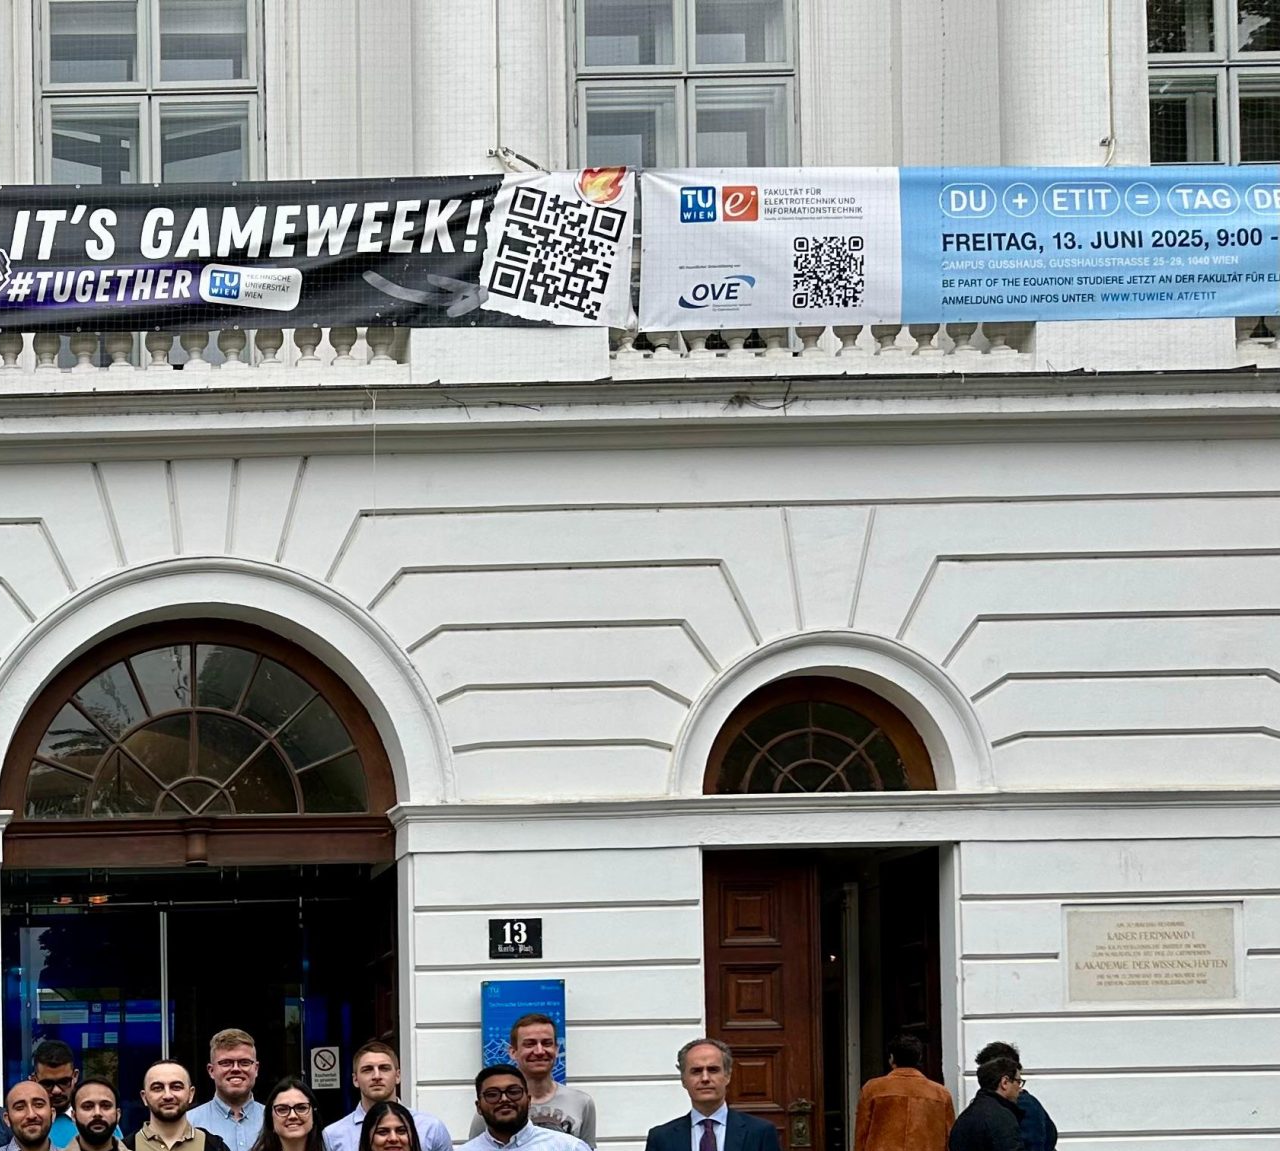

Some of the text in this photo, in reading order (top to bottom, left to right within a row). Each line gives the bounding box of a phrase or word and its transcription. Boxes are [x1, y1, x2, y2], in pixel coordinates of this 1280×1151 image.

[683, 189, 713, 208] TU
[764, 187, 821, 197] FAKULTÄT FÜR
[764, 197, 856, 206] ELEKTROTECHNIK UND
[950, 189, 987, 212] DU
[1053, 188, 1111, 211] ETIT
[1175, 189, 1231, 210] TAG
[683, 212, 714, 220] WIEN
[764, 206, 863, 215] INFORMATIONSTECHNIK
[9, 199, 484, 261] IT'S GAMEWEEK!
[942, 232, 1044, 254] FREITAG,
[1053, 232, 1082, 250] 13.
[1090, 230, 1143, 250] JUNI
[1151, 229, 1209, 251] 2025,
[1217, 228, 1263, 247] 9:00
[943, 260, 985, 271] CAMPUS
[1049, 256, 1150, 269] GUSSHAUSSTRASSE
[1188, 256, 1210, 265] 1040
[1211, 255, 1239, 265] WIEN
[7, 268, 193, 303] #TUGETHER
[211, 272, 240, 287] TU
[245, 281, 290, 293] UNIVERSITÄT
[942, 279, 955, 288] BE
[958, 279, 982, 288] PART
[985, 278, 999, 287] OF
[1001, 278, 1021, 287] THE
[1023, 276, 1074, 287] EQUATION!
[1076, 275, 1123, 286] STUDIERE
[1126, 275, 1156, 285] JETZT
[1158, 275, 1173, 284] AN
[1175, 274, 1195, 283] DER
[1197, 271, 1243, 283] FAKULTÄT
[1245, 271, 1265, 283] FÜR
[211, 287, 239, 299] WIEN
[245, 291, 263, 299] WIEN
[692, 283, 740, 301] OVE
[942, 294, 1004, 305] ANMELDUNG
[1006, 294, 1028, 304] UND
[1030, 294, 1059, 304] INFOS
[503, 921, 527, 944] 13
[1132, 960, 1150, 970] DER
